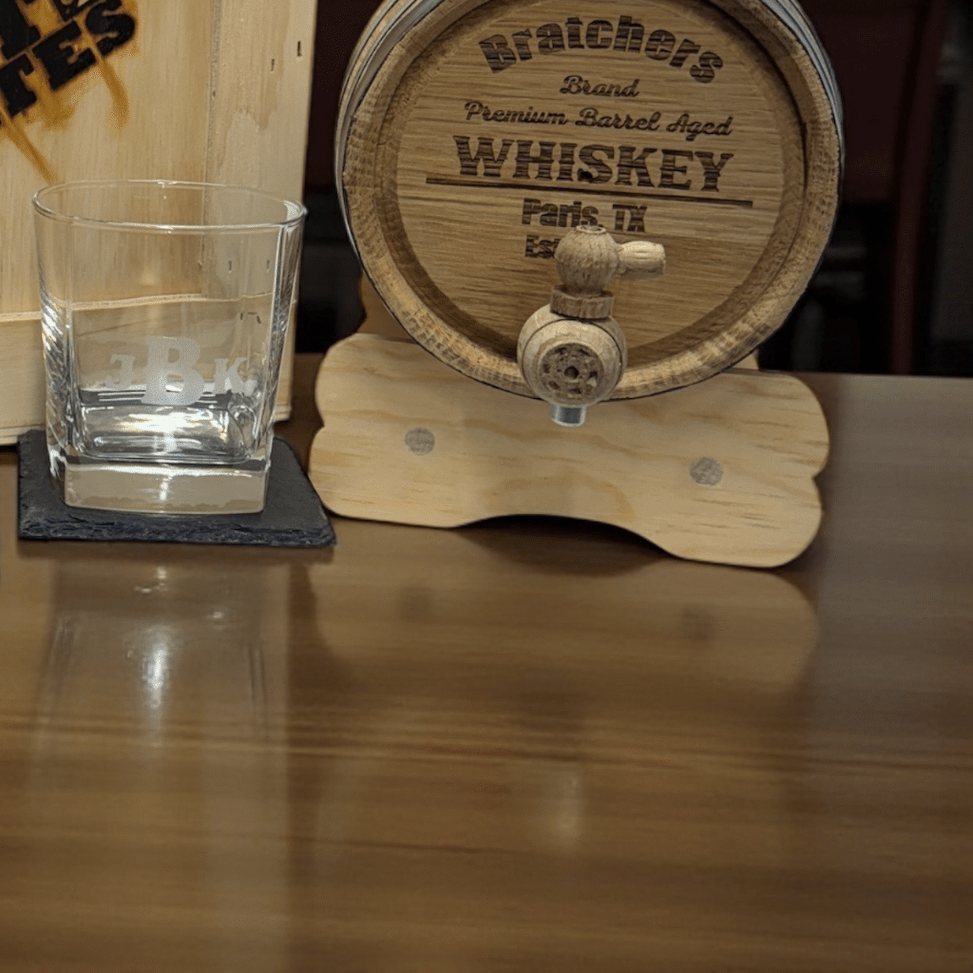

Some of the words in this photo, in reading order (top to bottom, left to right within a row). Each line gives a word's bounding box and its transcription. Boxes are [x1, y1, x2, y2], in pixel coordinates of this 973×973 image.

[478, 15, 724, 83] Bratchers
[559, 74, 640, 98] Brand
[463, 100, 568, 126] Premium
[574, 107, 661, 132] Barrel
[665, 113, 733, 142] Aged
[452, 135, 734, 193] WHISKEY
[611, 203, 648, 233] TX
